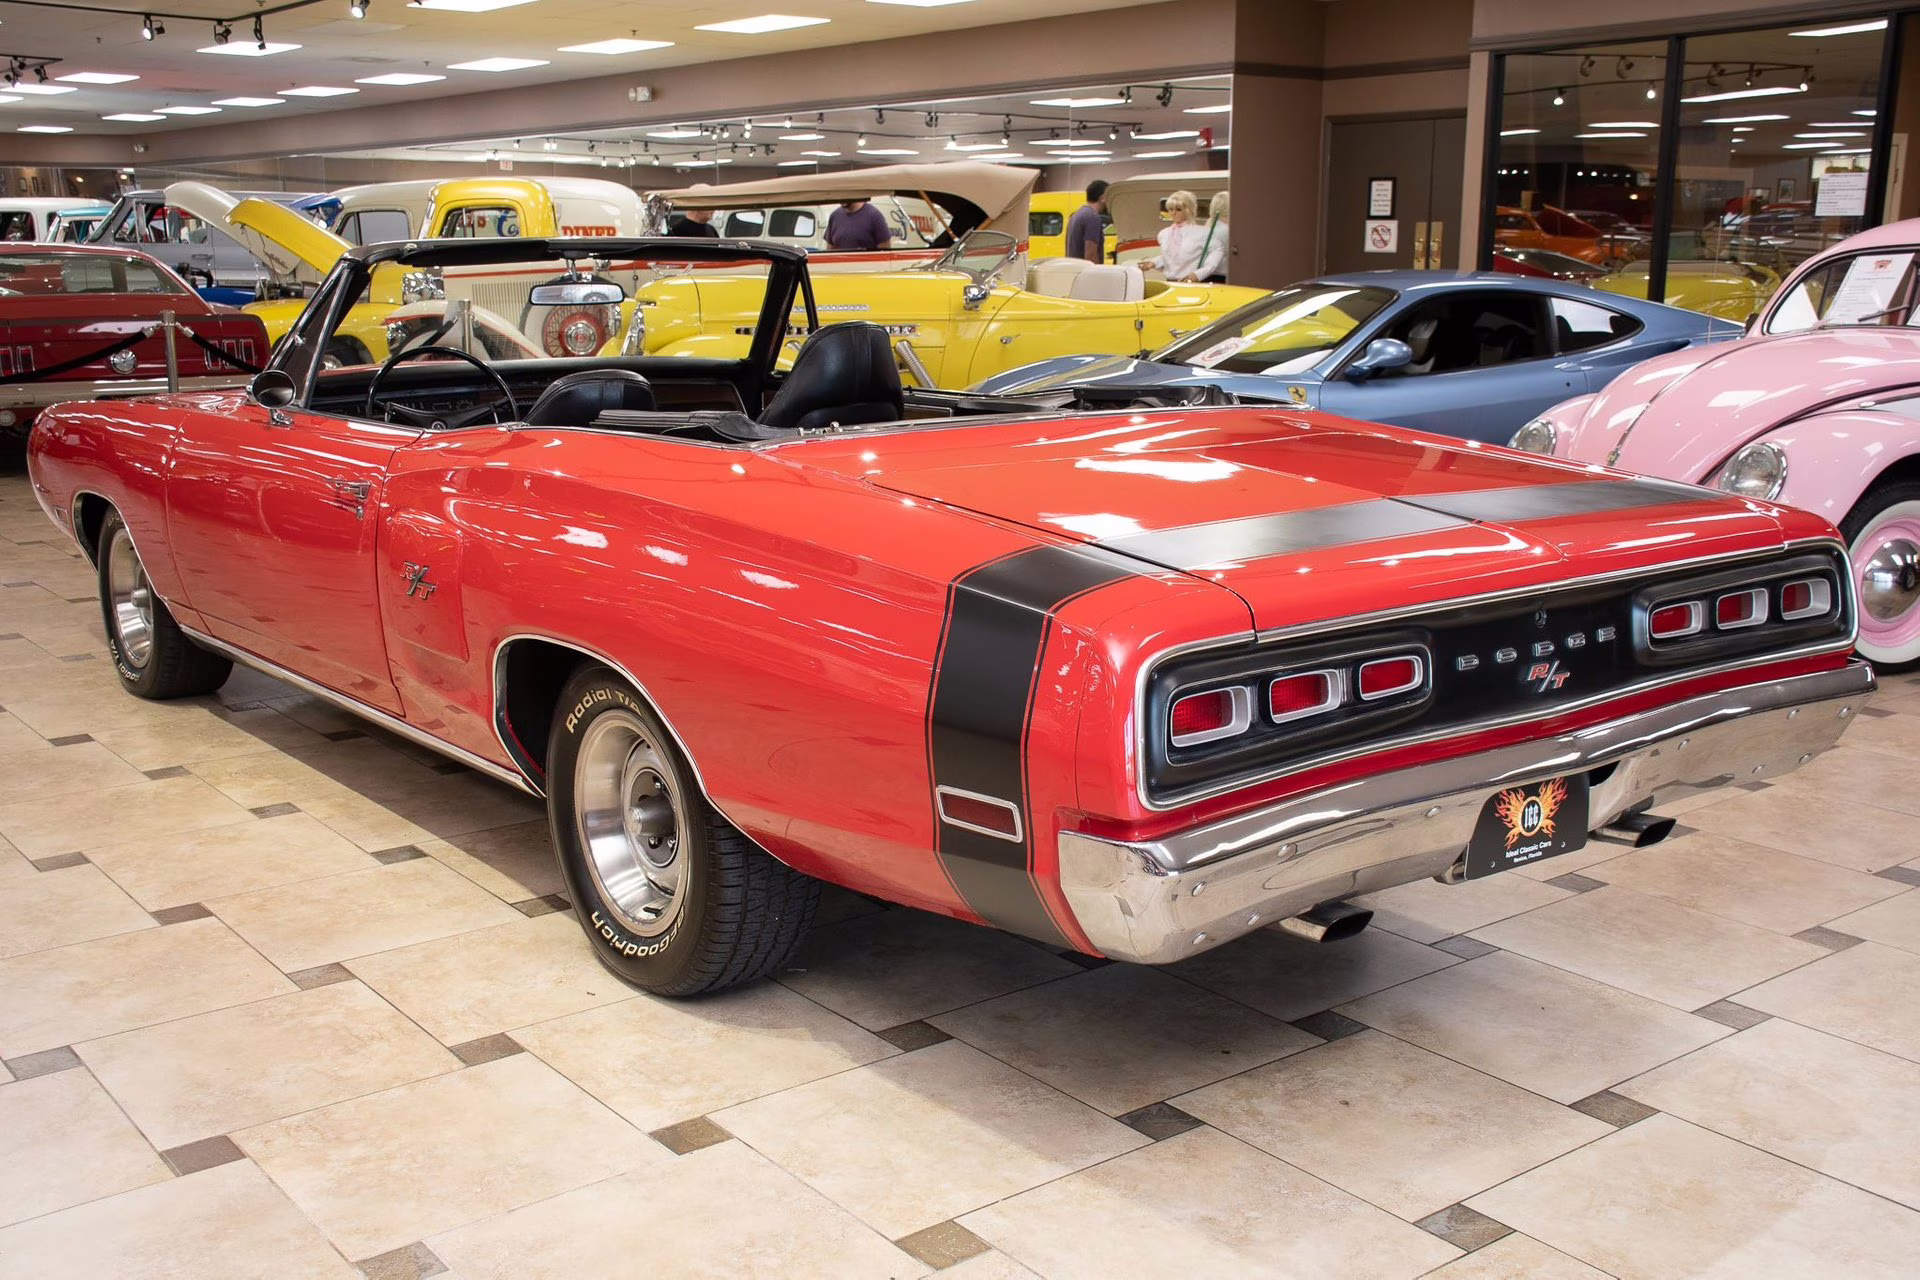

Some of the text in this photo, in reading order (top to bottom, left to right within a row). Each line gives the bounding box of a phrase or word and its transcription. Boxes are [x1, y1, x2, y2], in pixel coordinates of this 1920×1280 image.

[561, 225, 616, 237] DINER
[399, 560, 437, 600] R/T
[1457, 626, 1616, 671] DODGE
[1527, 659, 1571, 693] R/T
[566, 688, 612, 734] Radial
[1505, 841, 1552, 858] Ideal Classic Cars
